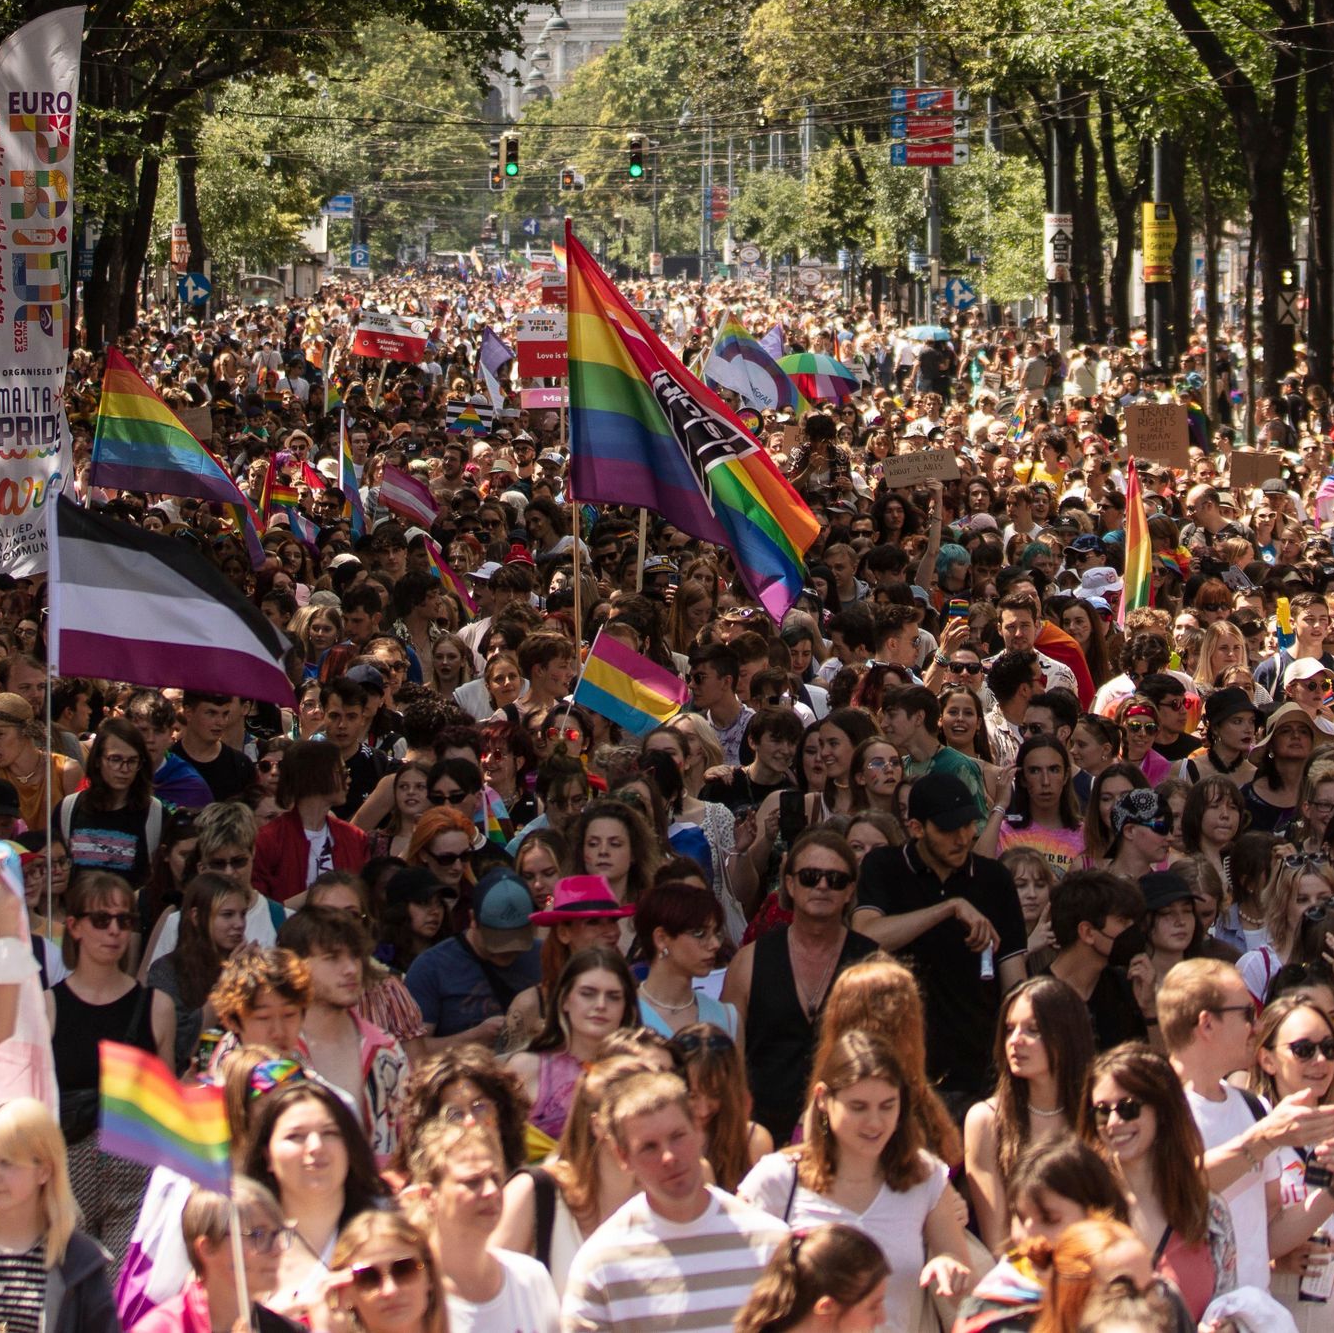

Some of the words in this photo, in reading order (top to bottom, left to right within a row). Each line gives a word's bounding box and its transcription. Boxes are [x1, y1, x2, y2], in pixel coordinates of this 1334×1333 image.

[9, 91, 72, 114] EURO
[356, 252, 365, 264] P
[14, 321, 23, 354] 2023
[376, 338, 405, 347] Salesforce
[2, 367, 52, 377] ORGANISED
[1138, 406, 1176, 418] TRANS
[1137, 417, 1177, 427] RIGHTS
[1137, 433, 1172, 442] HUMAN
